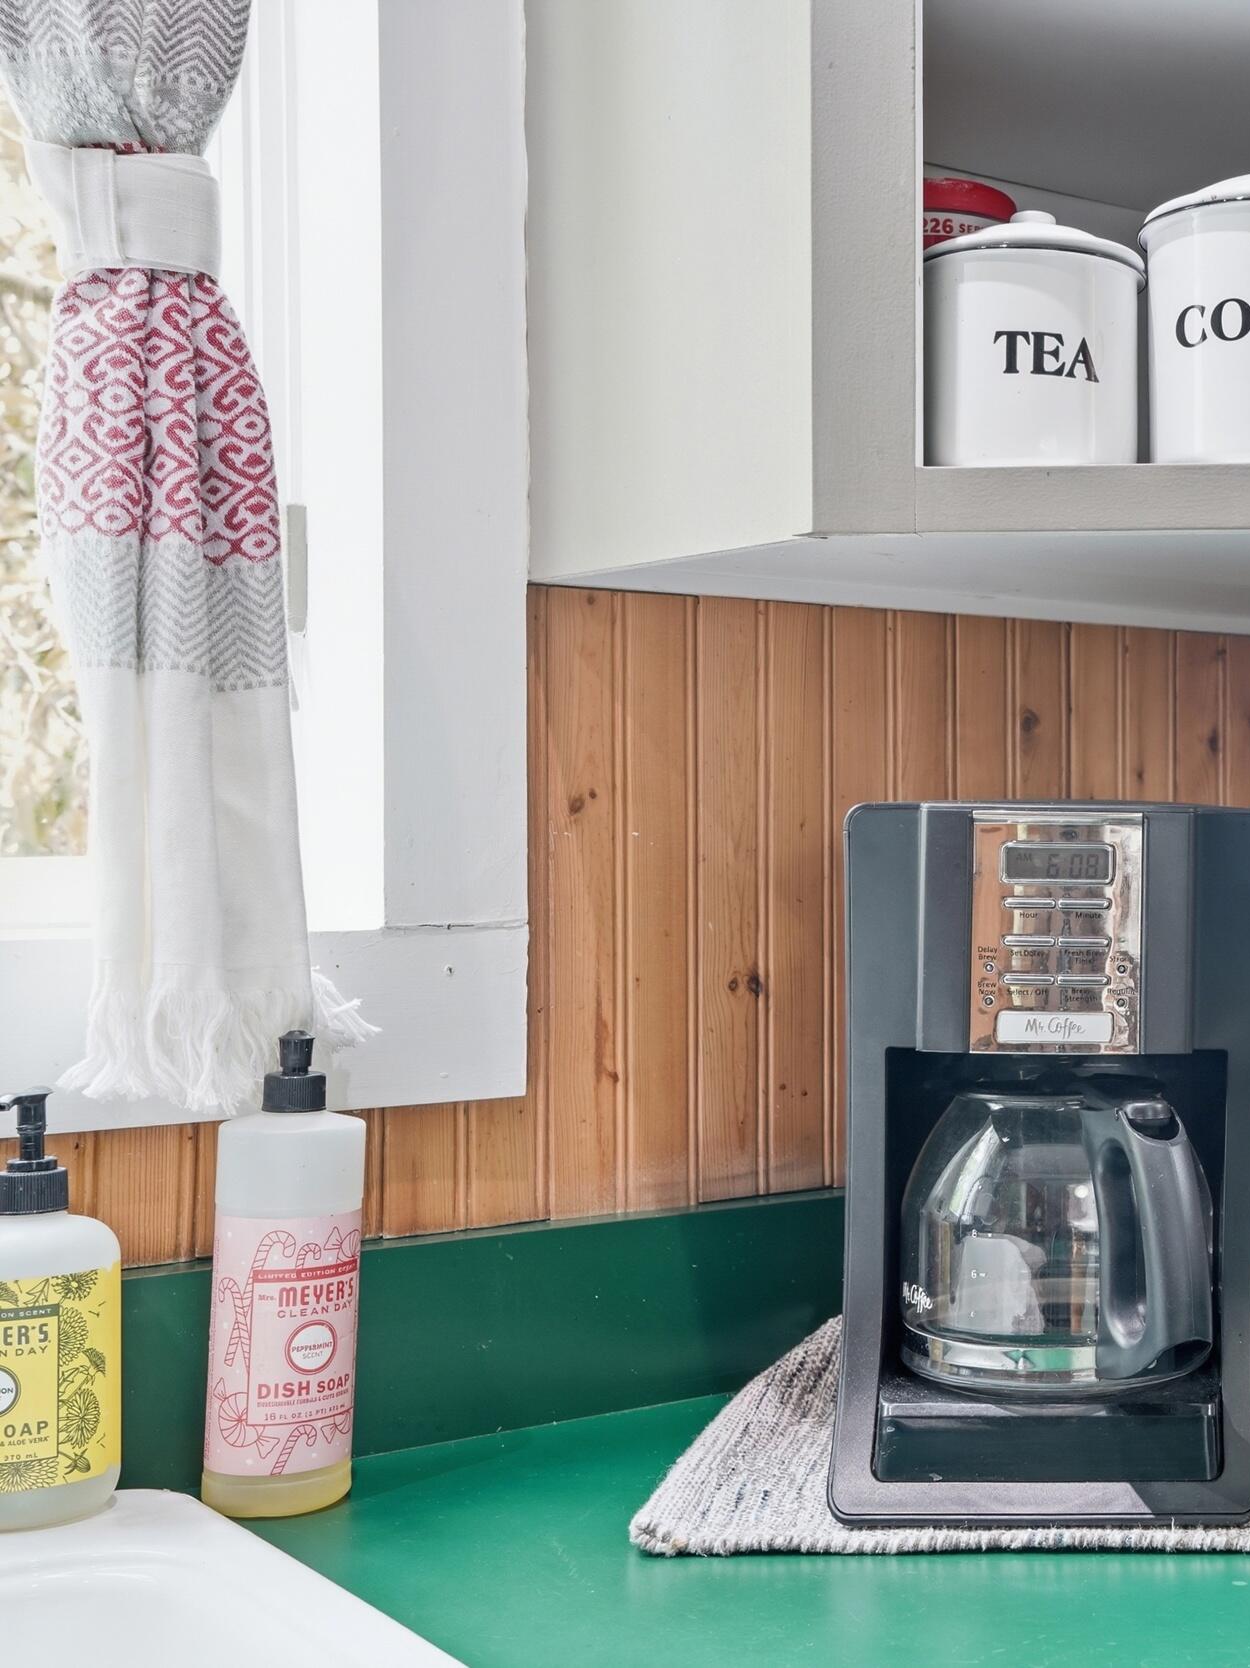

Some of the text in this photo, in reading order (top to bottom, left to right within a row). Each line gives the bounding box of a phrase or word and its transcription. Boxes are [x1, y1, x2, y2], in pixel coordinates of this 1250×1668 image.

[923, 218, 953, 234] 226
[994, 331, 1099, 383] TEA
[977, 946, 998, 954] Delay
[978, 988, 996, 996] Now
[1024, 1016, 1086, 1039] Mr. Coffee
[301, 1269, 336, 1278] EDITION
[971, 1270, 977, 1279] 6
[278, 1277, 353, 1308] MEYER'S
[19, 1308, 51, 1317] SCENT
[277, 1300, 352, 1319] CLEAN DAY
[3, 1323, 49, 1346] ER'S
[15, 1345, 48, 1357] DAY
[257, 1381, 311, 1399] DISH
[317, 1374, 350, 1393] SOAP
[264, 1413, 276, 1421] 16
[4, 1420, 49, 1438] OAP
